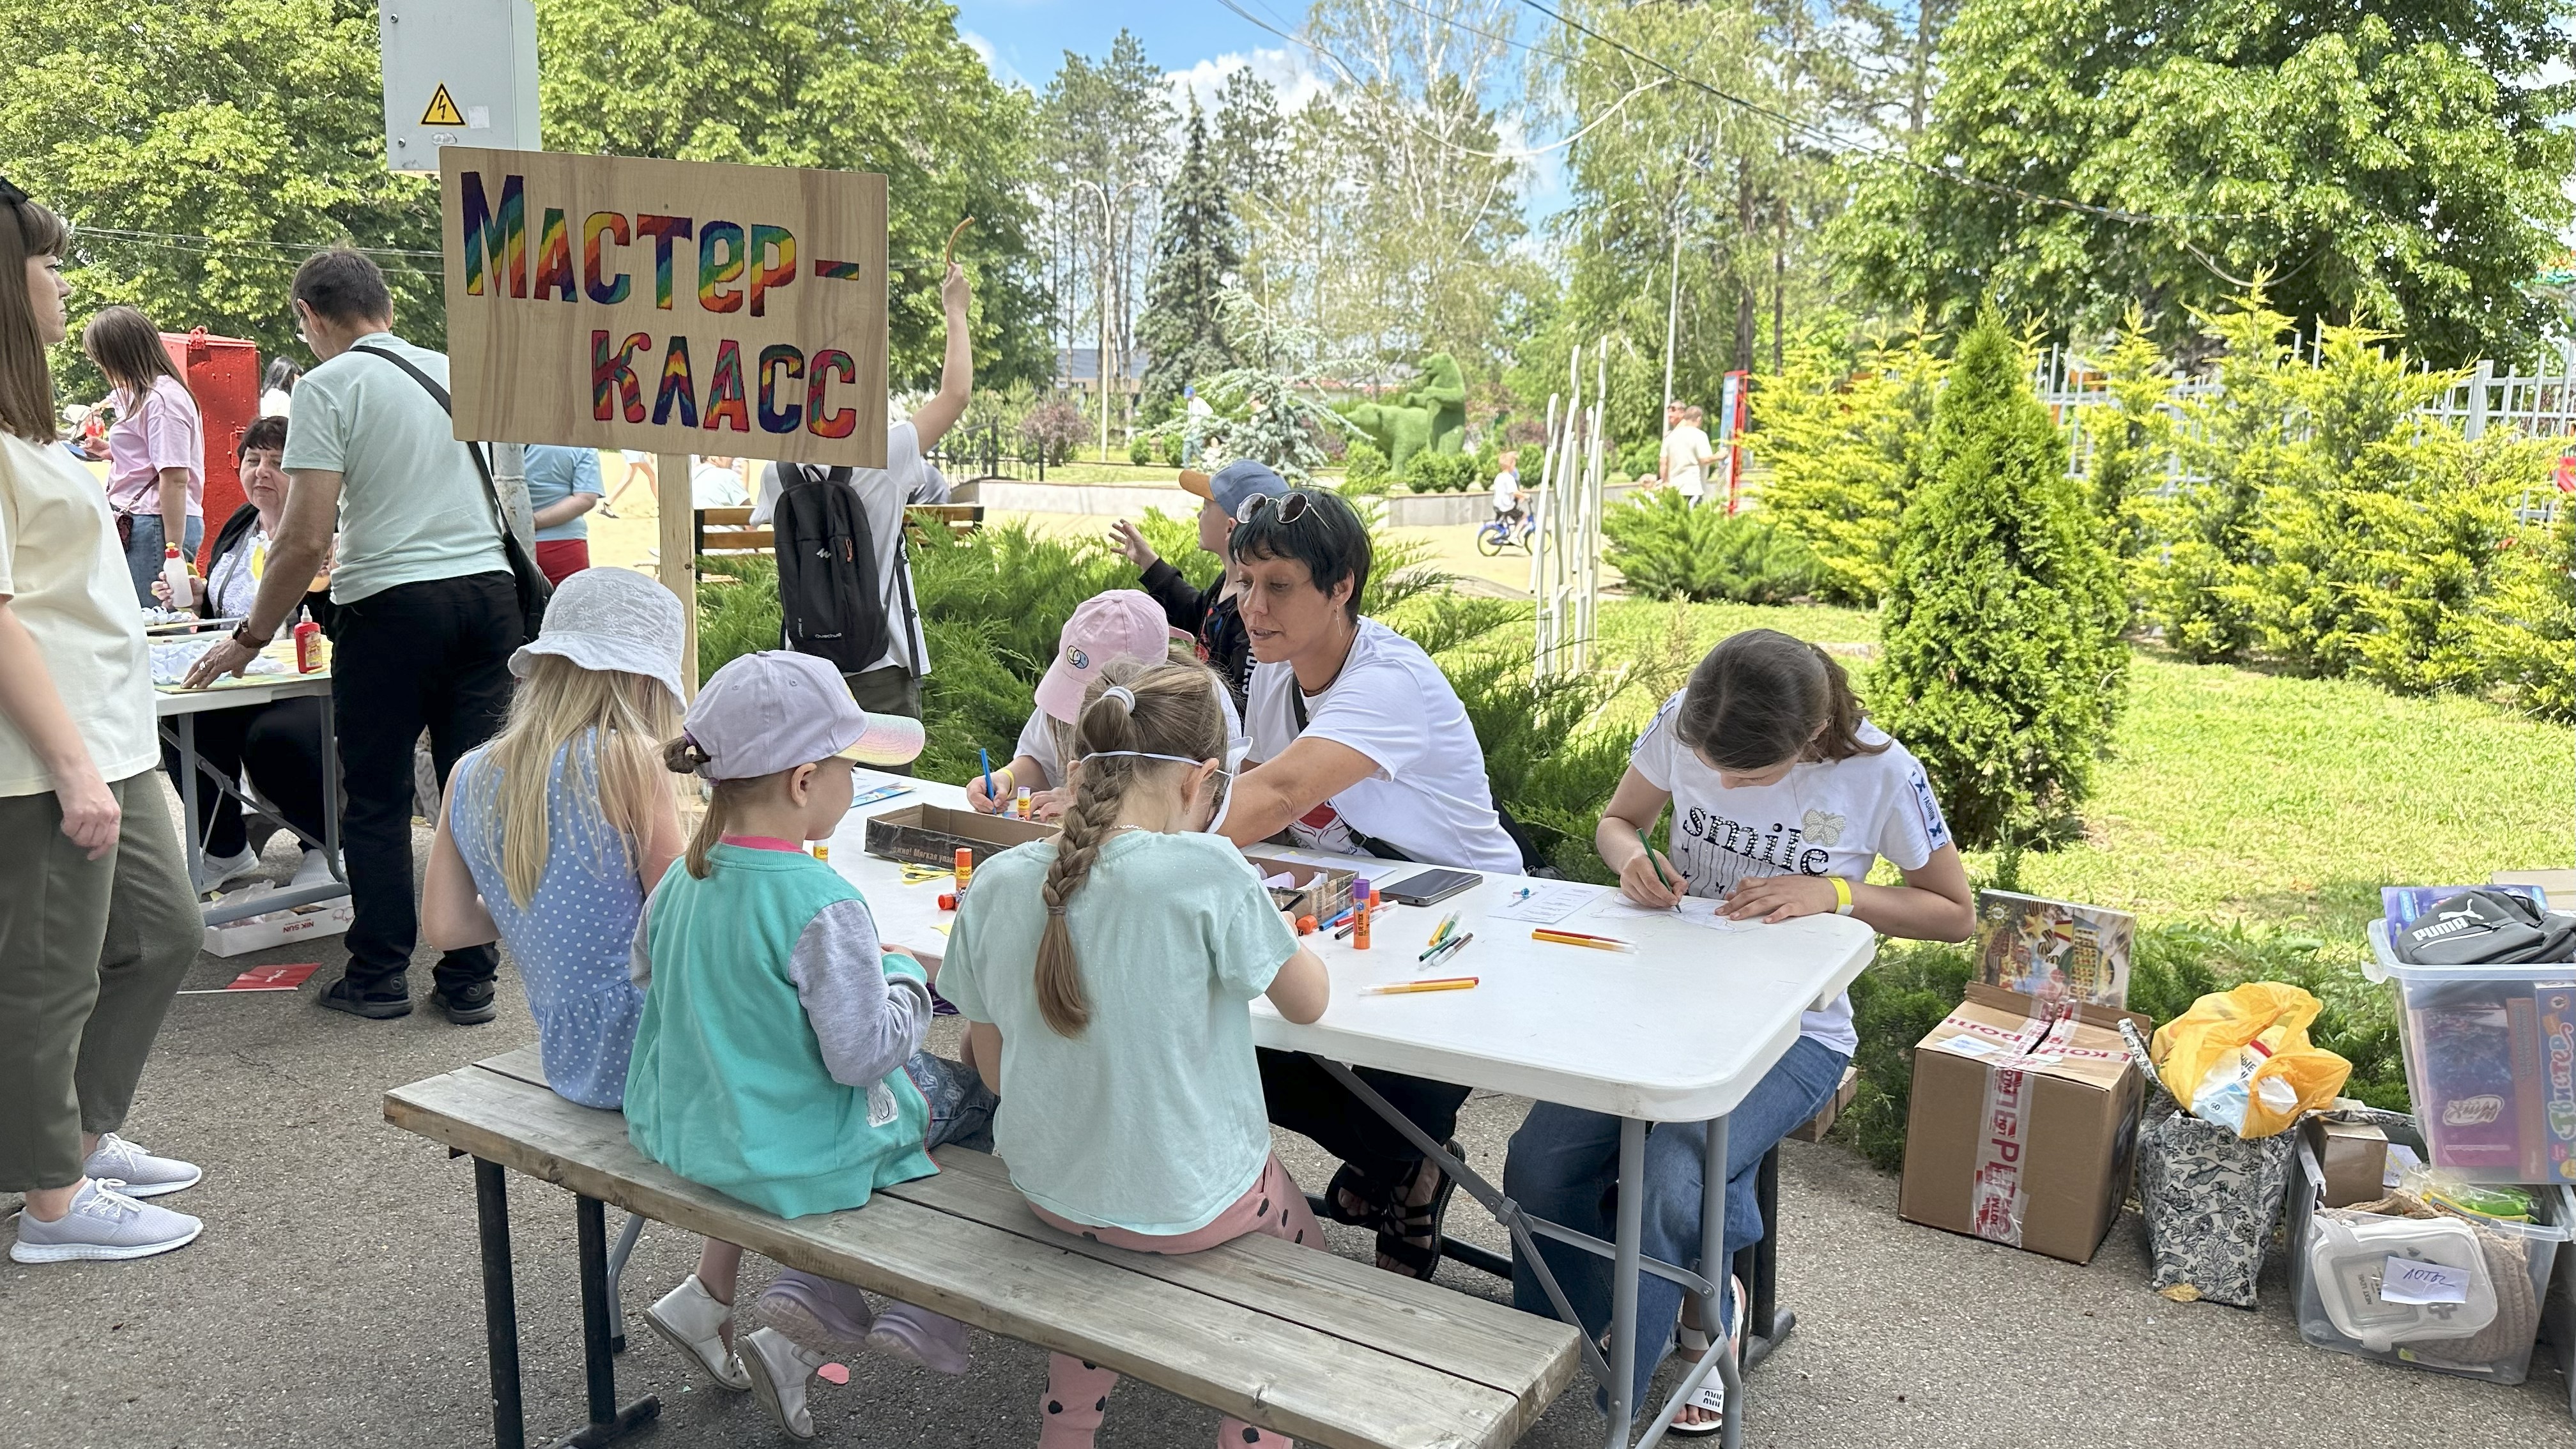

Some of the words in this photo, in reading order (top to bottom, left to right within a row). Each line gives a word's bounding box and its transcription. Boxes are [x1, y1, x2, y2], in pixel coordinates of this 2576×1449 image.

[592, 330, 857, 439] КЛАСС
[1922, 795, 1935, 822] FASHION
[914, 848, 937, 860] Мягкая
[1683, 805, 1829, 877] smile
[2412, 917, 2468, 941] PUMA
